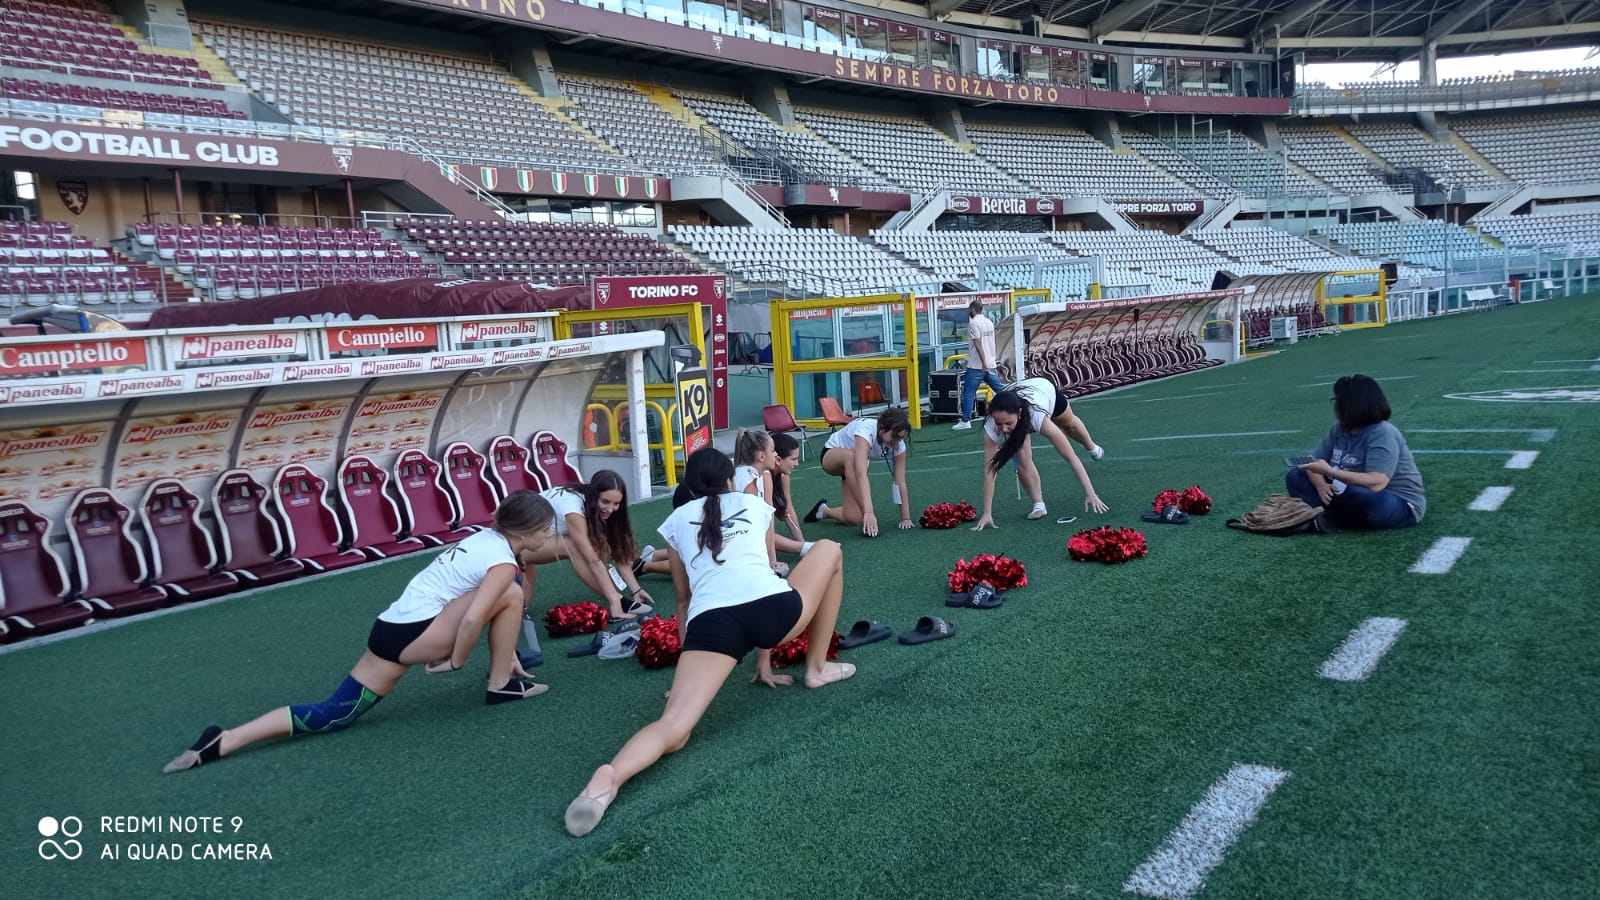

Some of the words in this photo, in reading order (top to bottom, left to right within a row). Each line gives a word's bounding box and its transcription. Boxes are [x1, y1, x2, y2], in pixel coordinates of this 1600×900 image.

[453, 0, 545, 20] NO
[835, 57, 921, 88] SEMPRE
[934, 72, 995, 98] FORZA
[1005, 84, 1059, 103] TORO
[0, 125, 190, 160] FOOTBALL
[196, 141, 279, 166] CLUB
[981, 197, 1027, 214] Beretta
[1112, 203, 1139, 212] EMPRE
[1141, 203, 1170, 212] FORZA
[1171, 203, 1196, 211] TORO
[629, 286, 678, 298] TORINO
[681, 285, 698, 296] FC
[479, 320, 536, 337] panealba
[207, 333, 293, 352] panealba
[338, 327, 425, 348] Campiello
[0, 342, 128, 369] Campiello
[444, 354, 484, 368] panealba
[503, 349, 541, 362] panealba
[299, 364, 350, 379] panealba
[375, 359, 421, 373] panealba
[119, 377, 181, 394] panealba
[214, 370, 271, 386] panealba
[11, 384, 82, 402] panealba
[379, 398, 437, 412] panealba
[684, 384, 705, 430] K9
[274, 407, 341, 423] panealba
[151, 419, 229, 440] panealba
[8, 432, 98, 452] panealba
